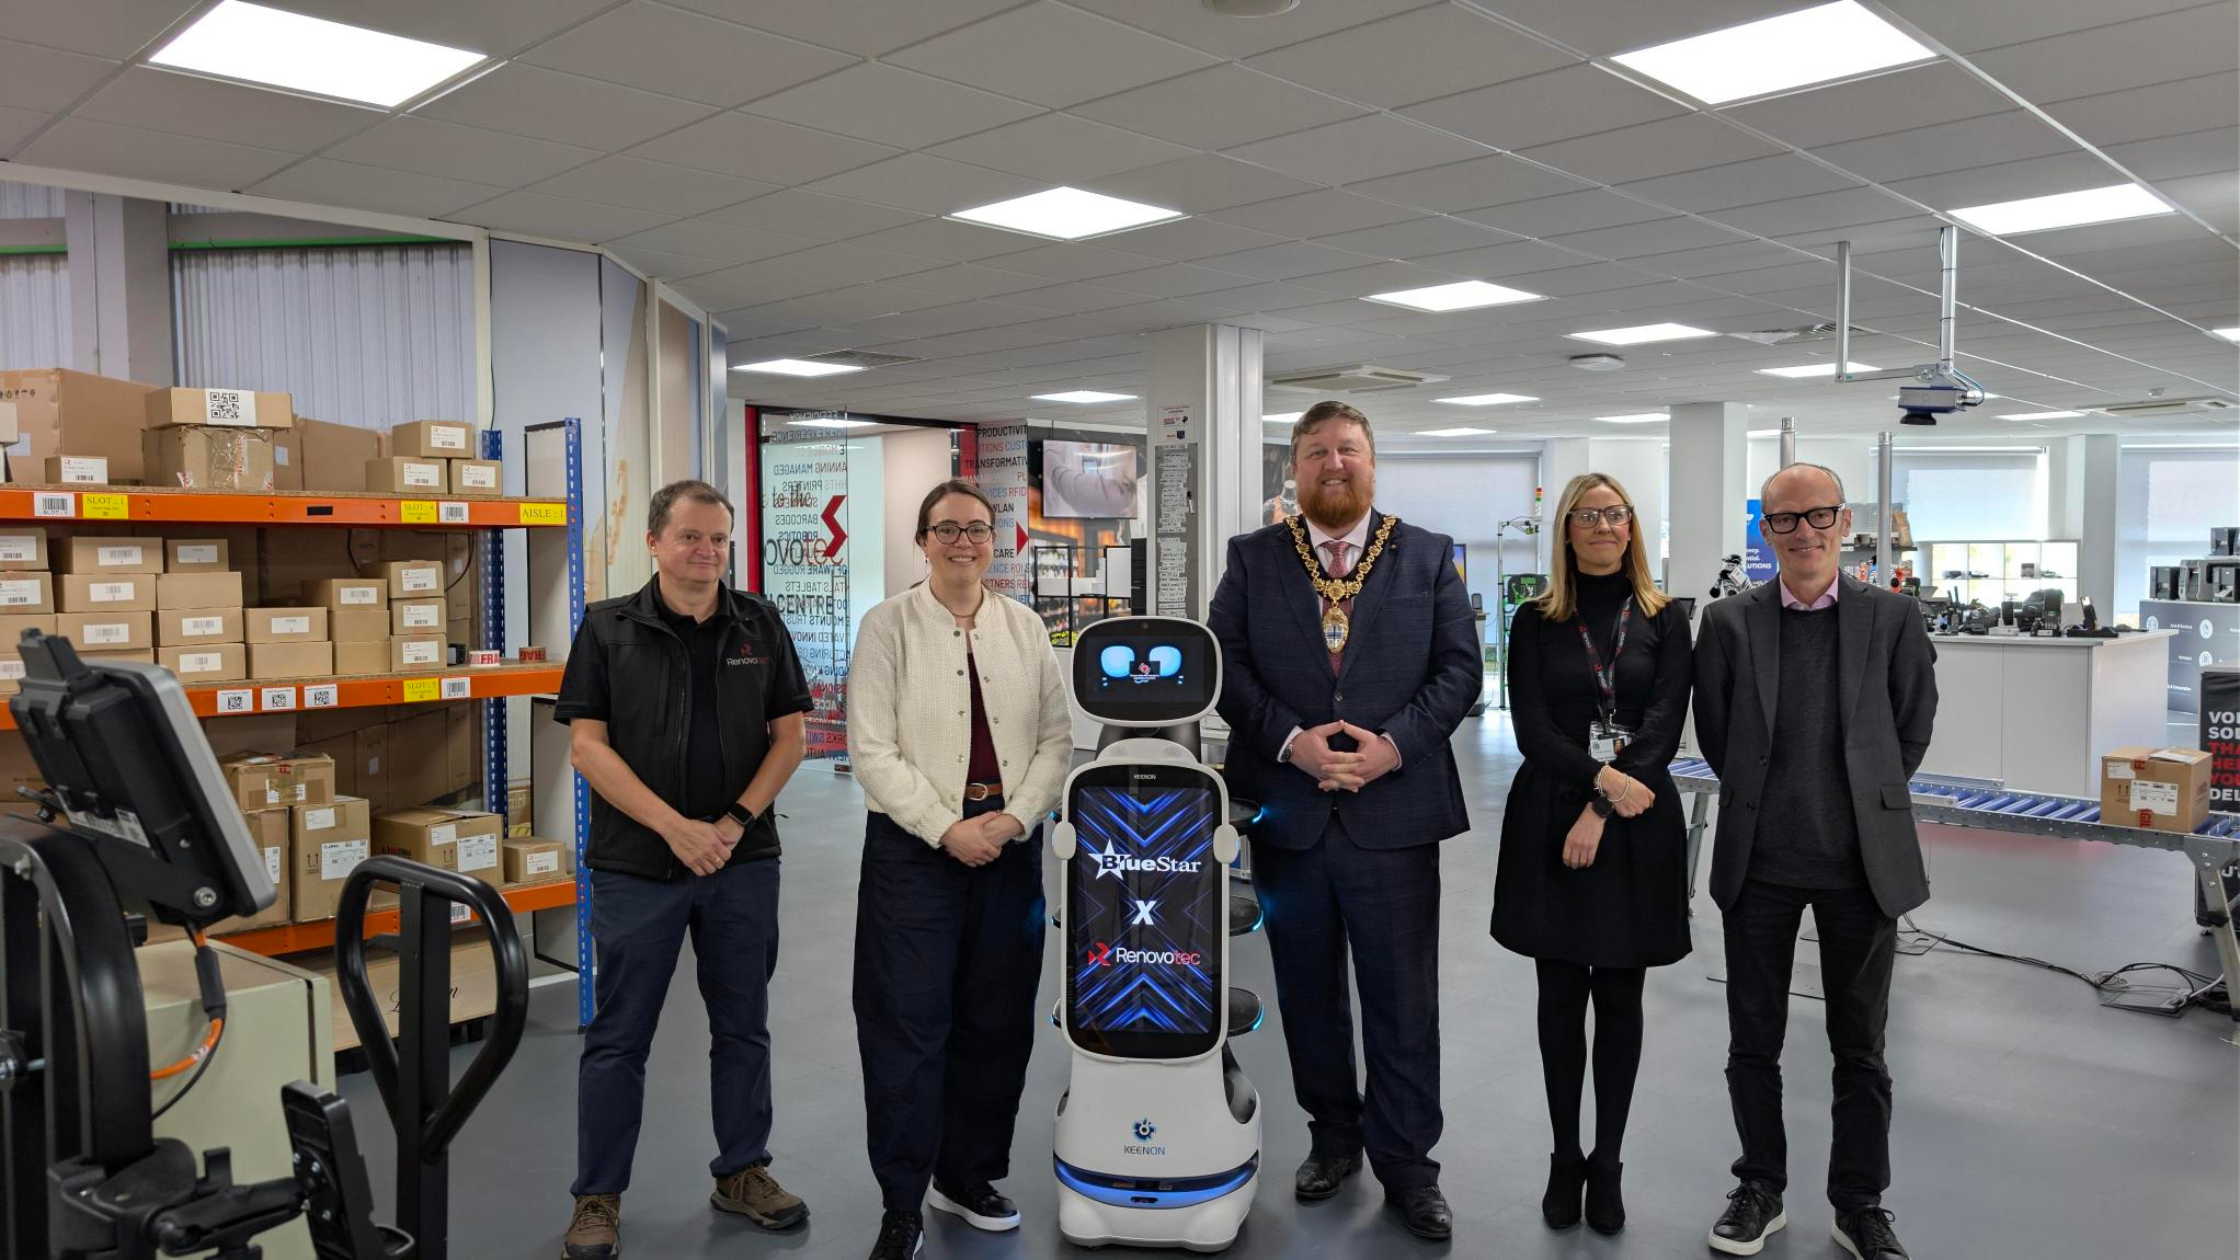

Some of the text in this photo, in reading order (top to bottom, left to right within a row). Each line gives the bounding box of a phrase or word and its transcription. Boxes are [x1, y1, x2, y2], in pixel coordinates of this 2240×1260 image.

[86, 496, 113, 505] SLOT
[403, 503, 423, 511] SLOT
[522, 508, 552, 518] AISLE
[777, 594, 834, 615] CENTRE
[1101, 855, 1202, 873] BlueStar
[1116, 947, 1201, 965] Renovotec
[1123, 1145, 1166, 1156] KEENON
